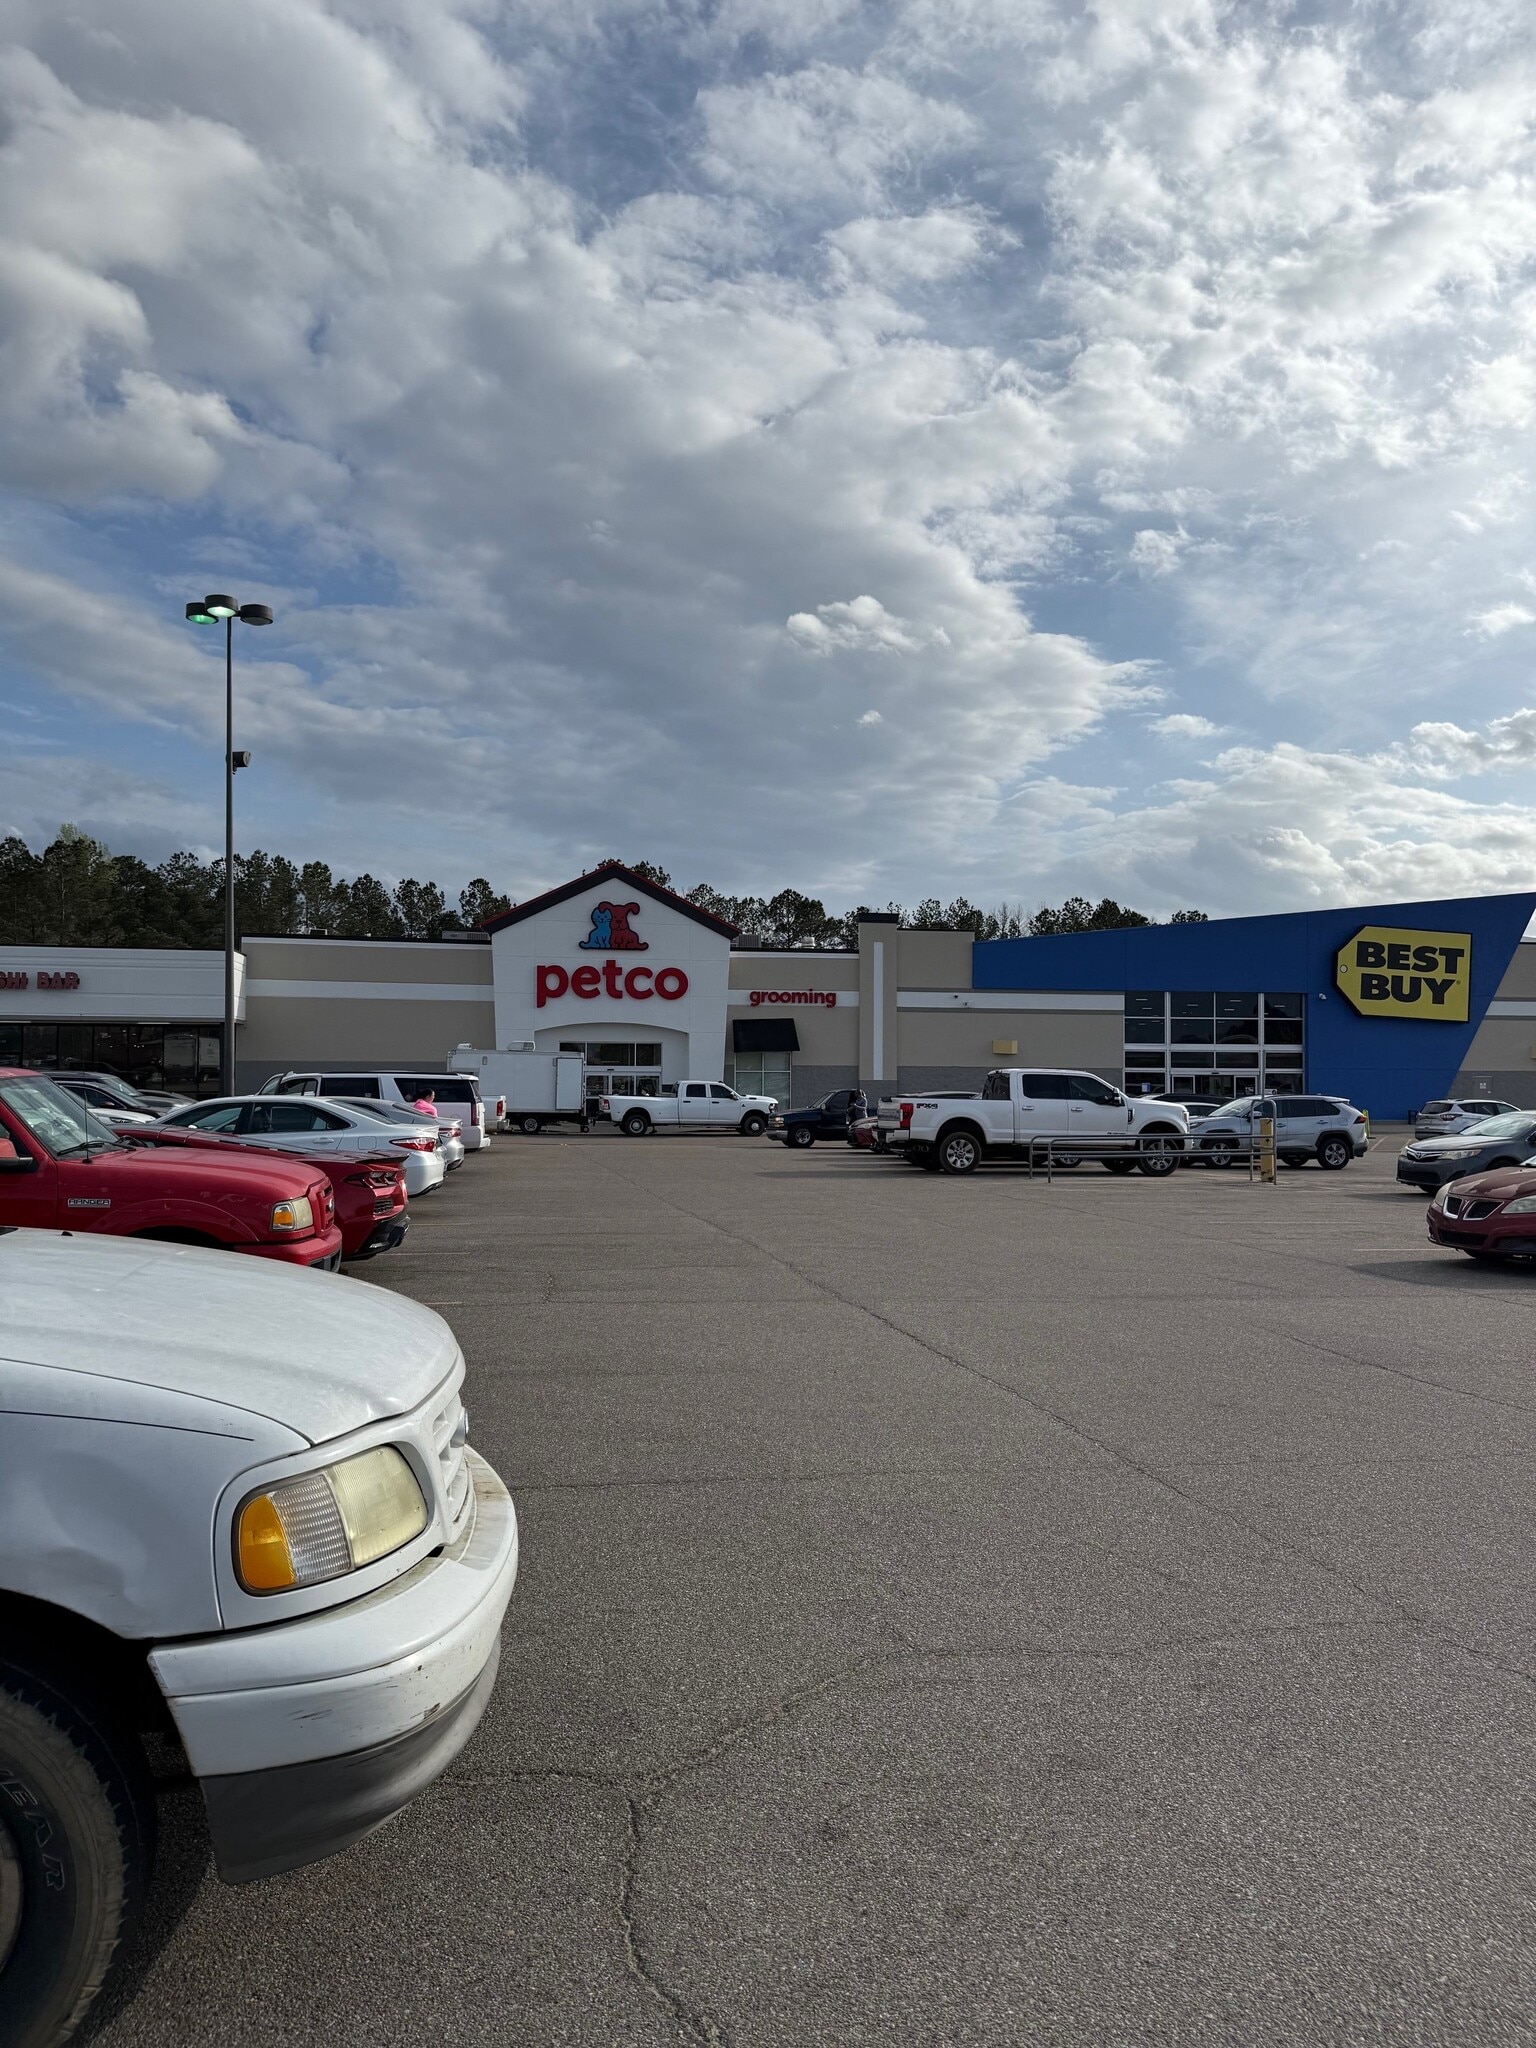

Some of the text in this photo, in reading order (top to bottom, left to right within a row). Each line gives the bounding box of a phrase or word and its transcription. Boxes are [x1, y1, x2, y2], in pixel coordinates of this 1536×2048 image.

[1356, 941, 1465, 974] BEST
[37, 972, 80, 989] BAR
[536, 960, 689, 1008] petco
[1360, 973, 1456, 1005] BUY
[749, 989, 836, 1008] grooming
[69, 1199, 110, 1207] RANGER
[0, 1769, 65, 1891] EAR
